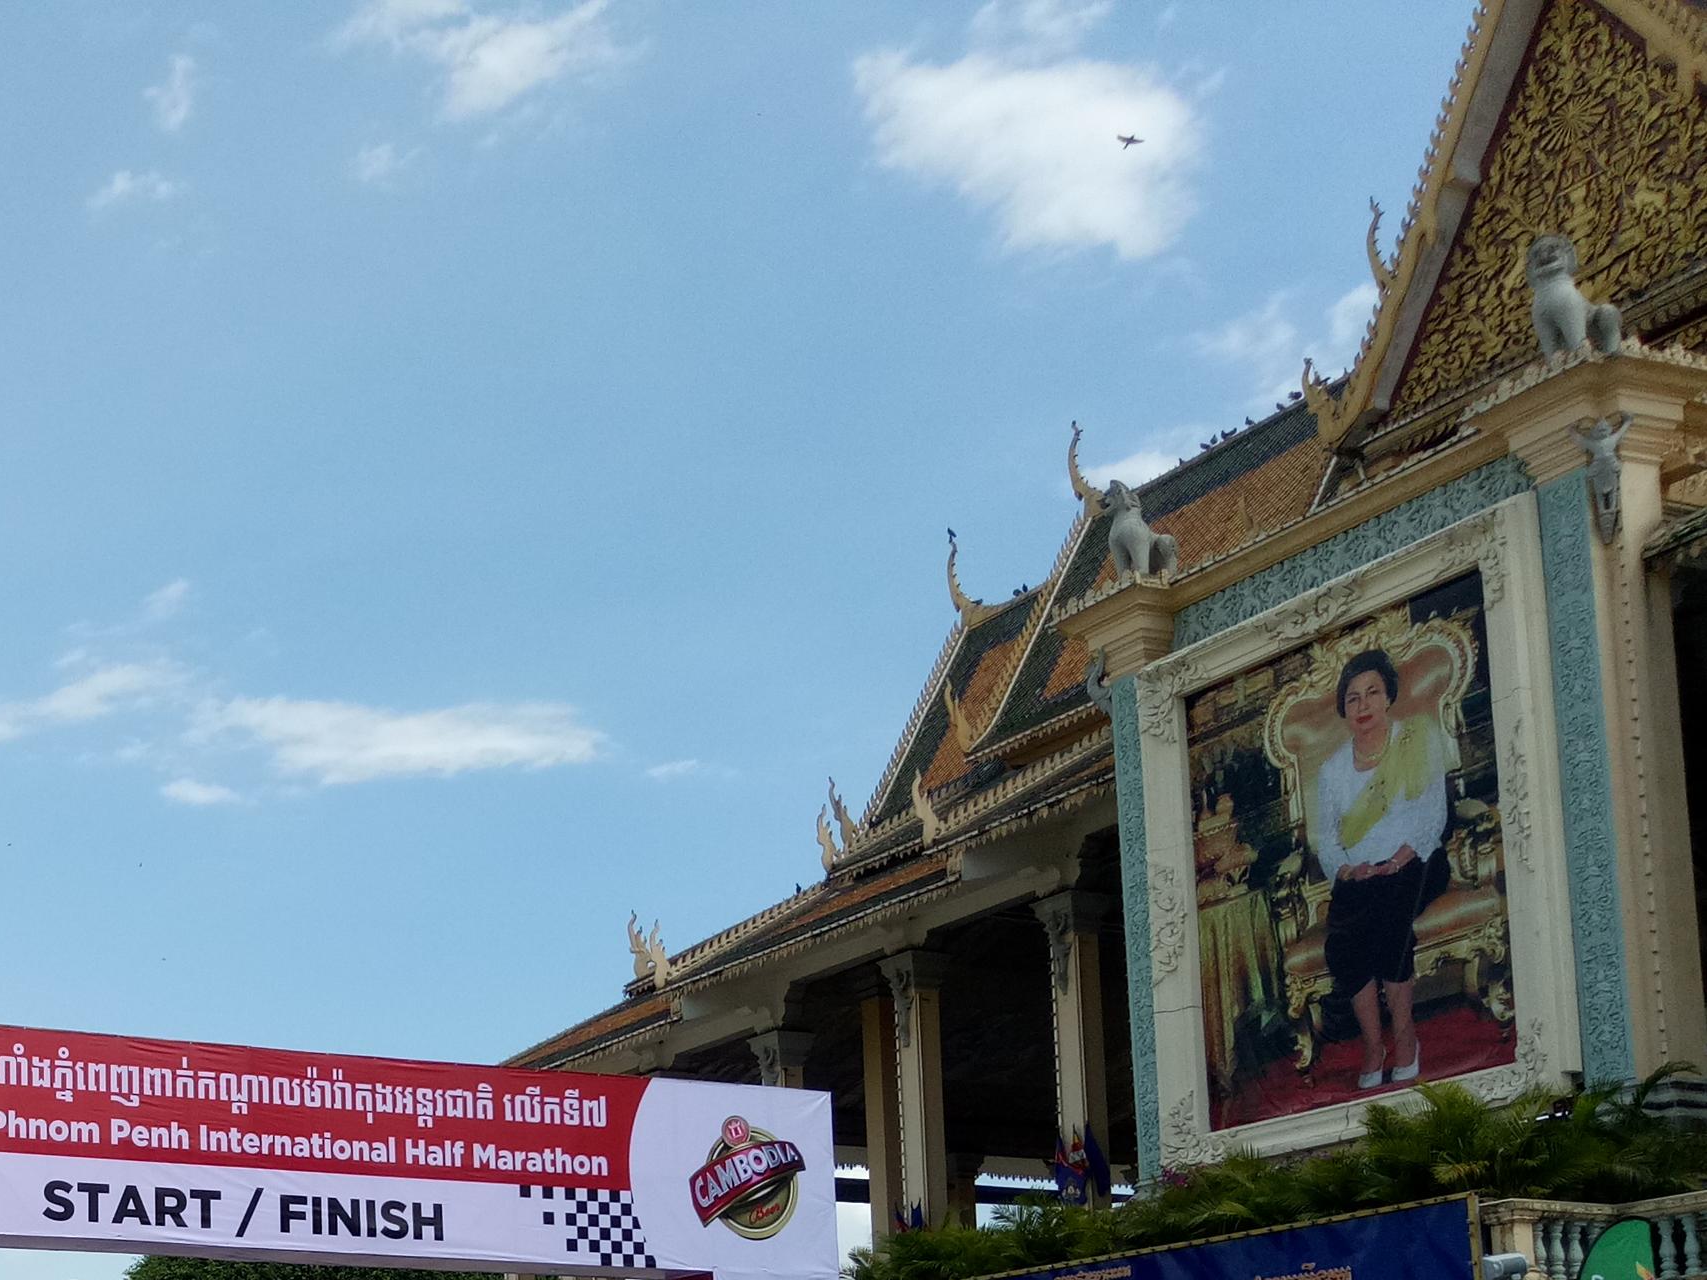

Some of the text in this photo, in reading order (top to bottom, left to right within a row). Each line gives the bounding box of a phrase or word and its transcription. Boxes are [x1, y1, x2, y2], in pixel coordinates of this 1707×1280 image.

[110, 1118, 190, 1150] Penh
[199, 1125, 396, 1164] International
[405, 1138, 464, 1168] Half
[473, 1144, 608, 1177] Marathon
[694, 1143, 798, 1208] CAMBODIA
[42, 1180, 445, 1241] START / FINISH
